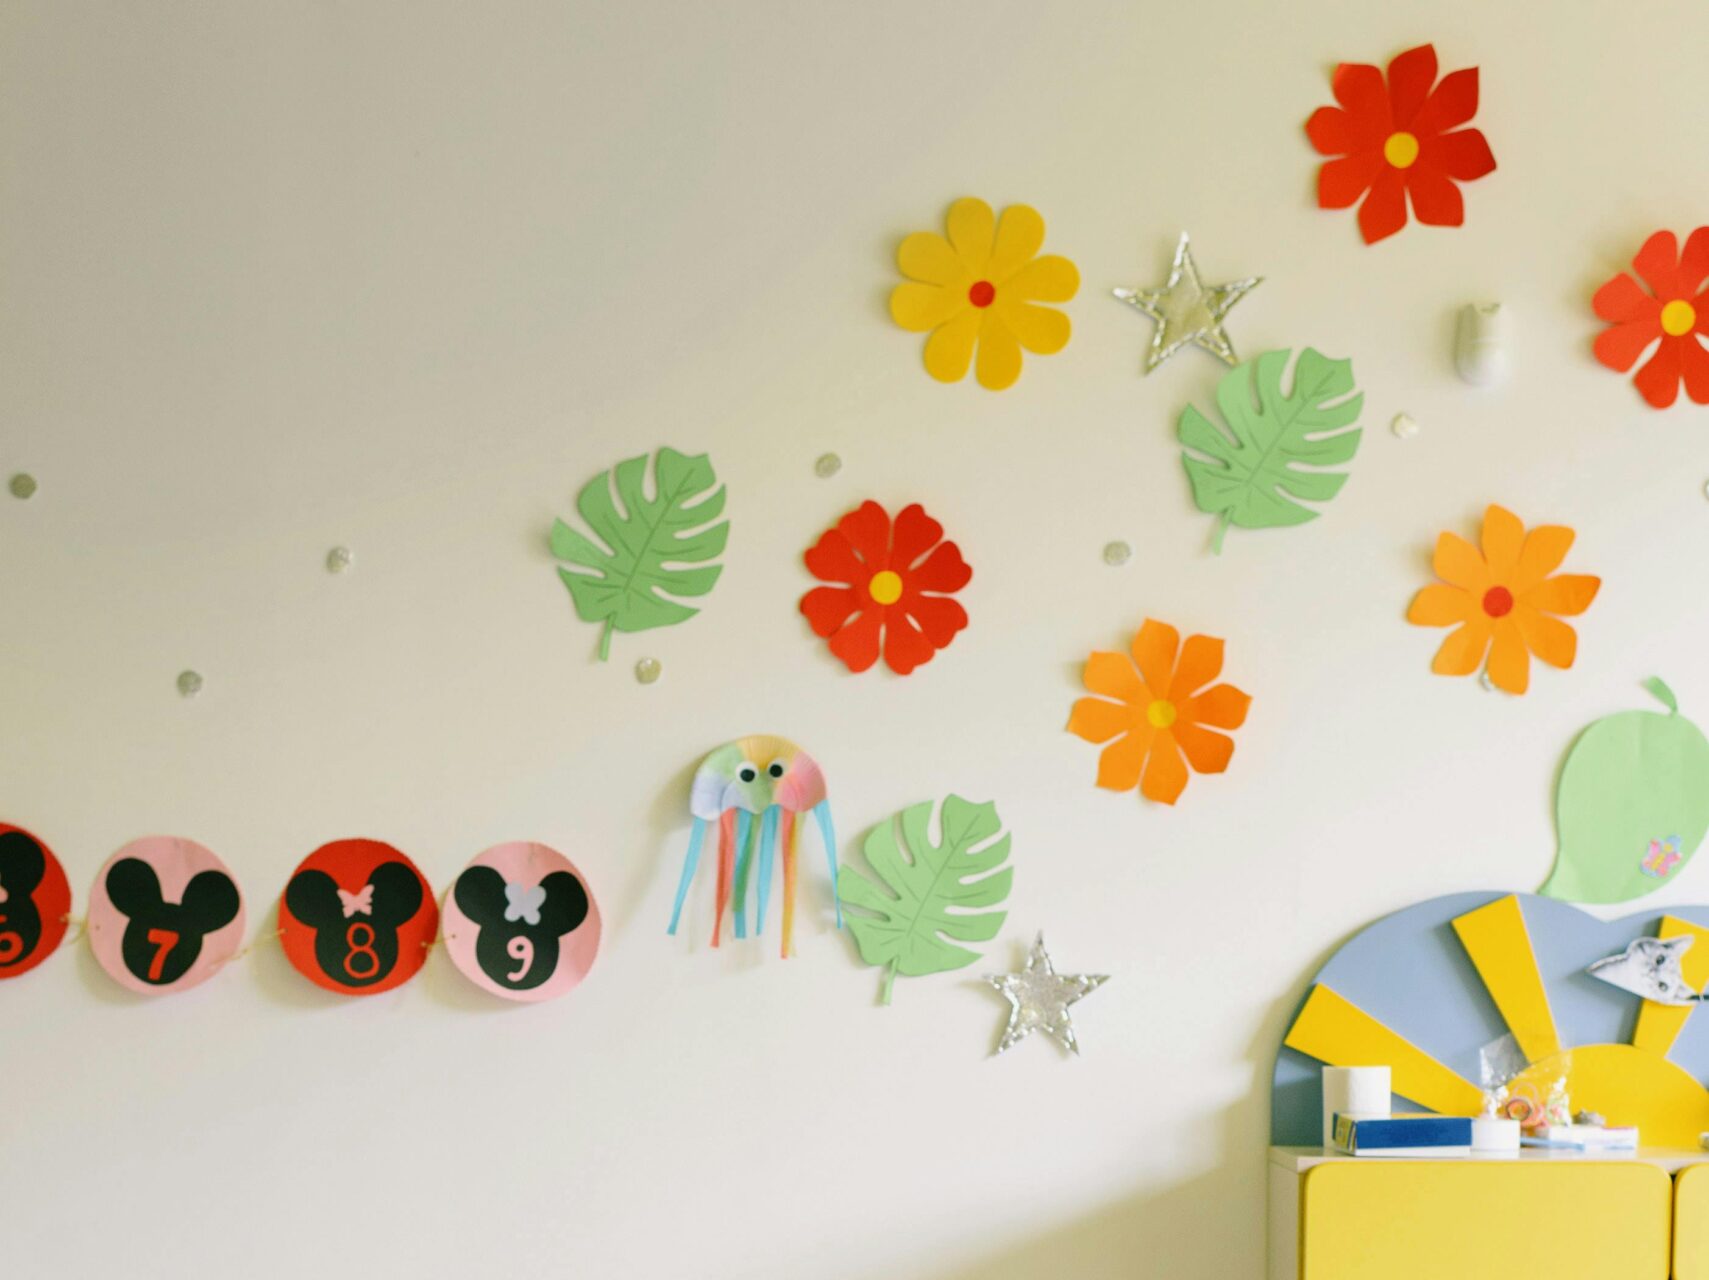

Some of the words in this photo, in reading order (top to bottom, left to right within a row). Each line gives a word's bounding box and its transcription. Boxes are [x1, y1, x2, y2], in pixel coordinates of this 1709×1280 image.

[146, 928, 179, 980] 7
[343, 922, 380, 979] 8
[506, 935, 535, 982] 9
